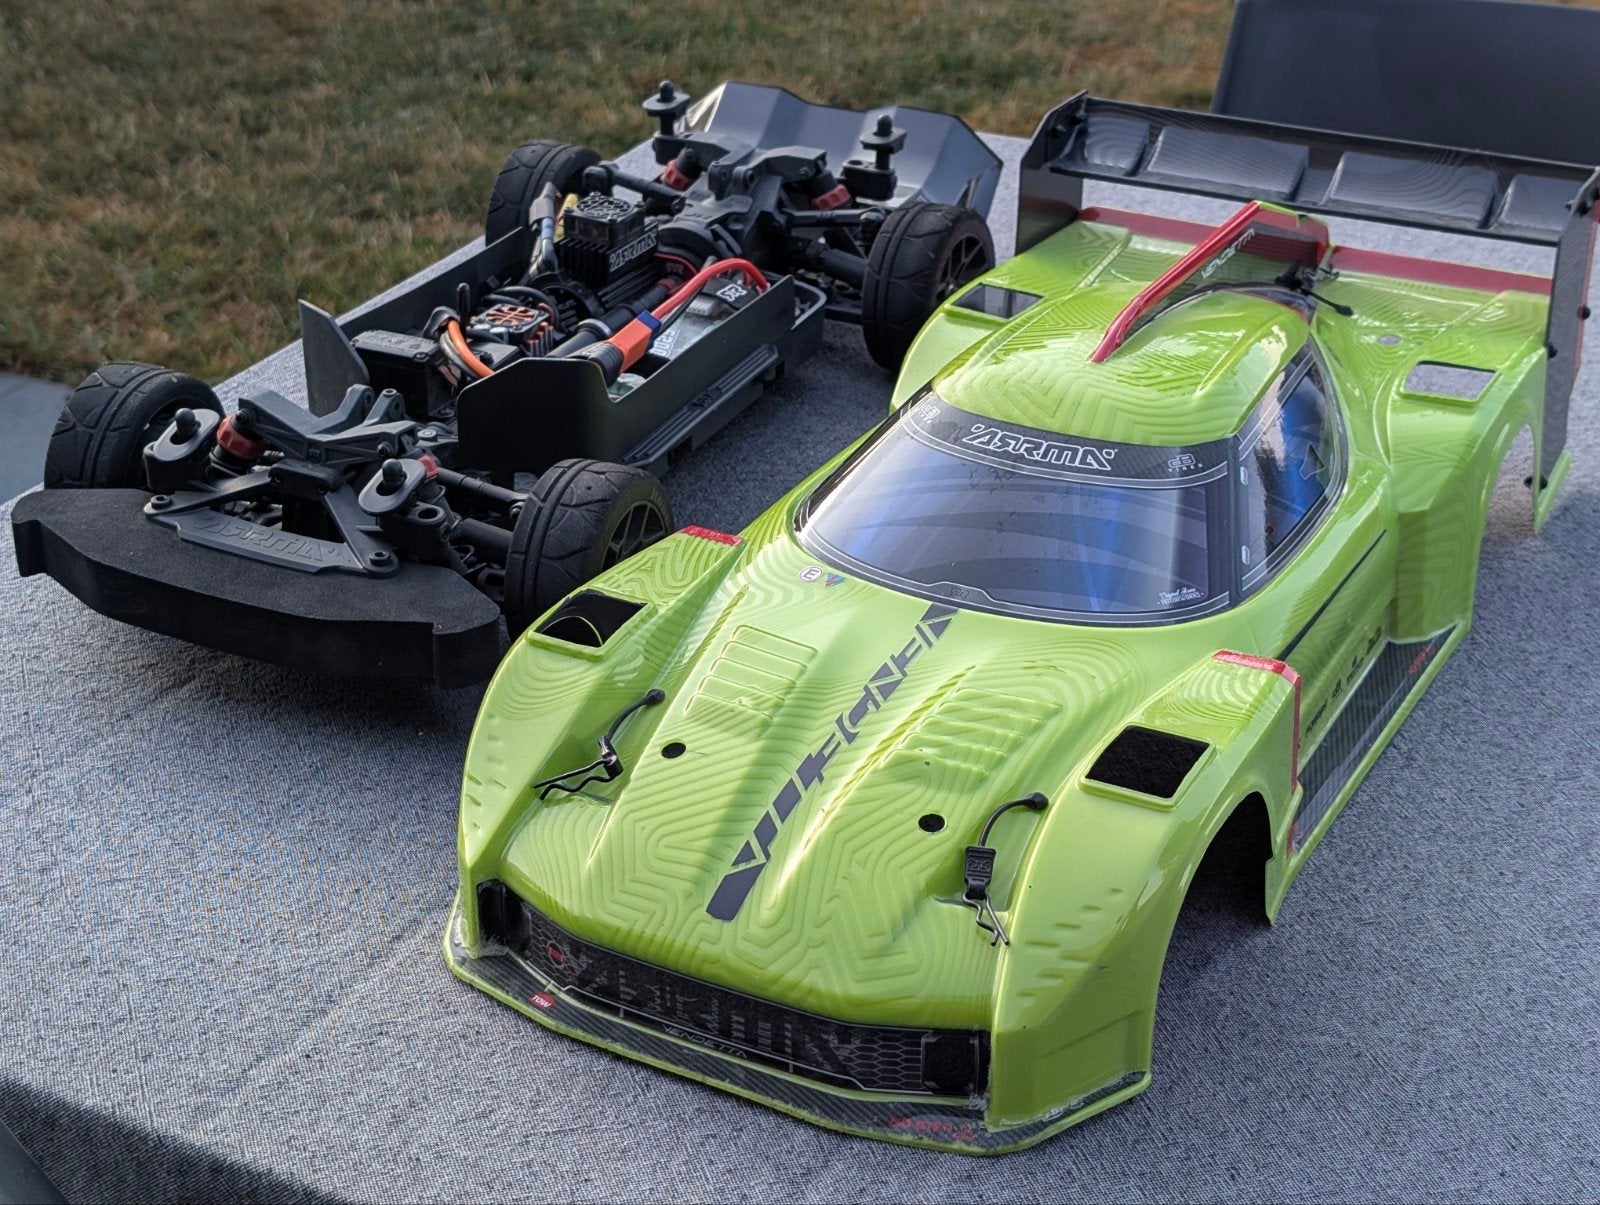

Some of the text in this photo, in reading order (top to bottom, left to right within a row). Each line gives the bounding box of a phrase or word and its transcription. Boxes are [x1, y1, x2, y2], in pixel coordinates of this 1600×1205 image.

[1201, 228, 1256, 279] VENDETTA
[962, 424, 1115, 470] ARRMA
[532, 995, 552, 1008] TOW
[662, 1024, 750, 1060] VENDETTA
